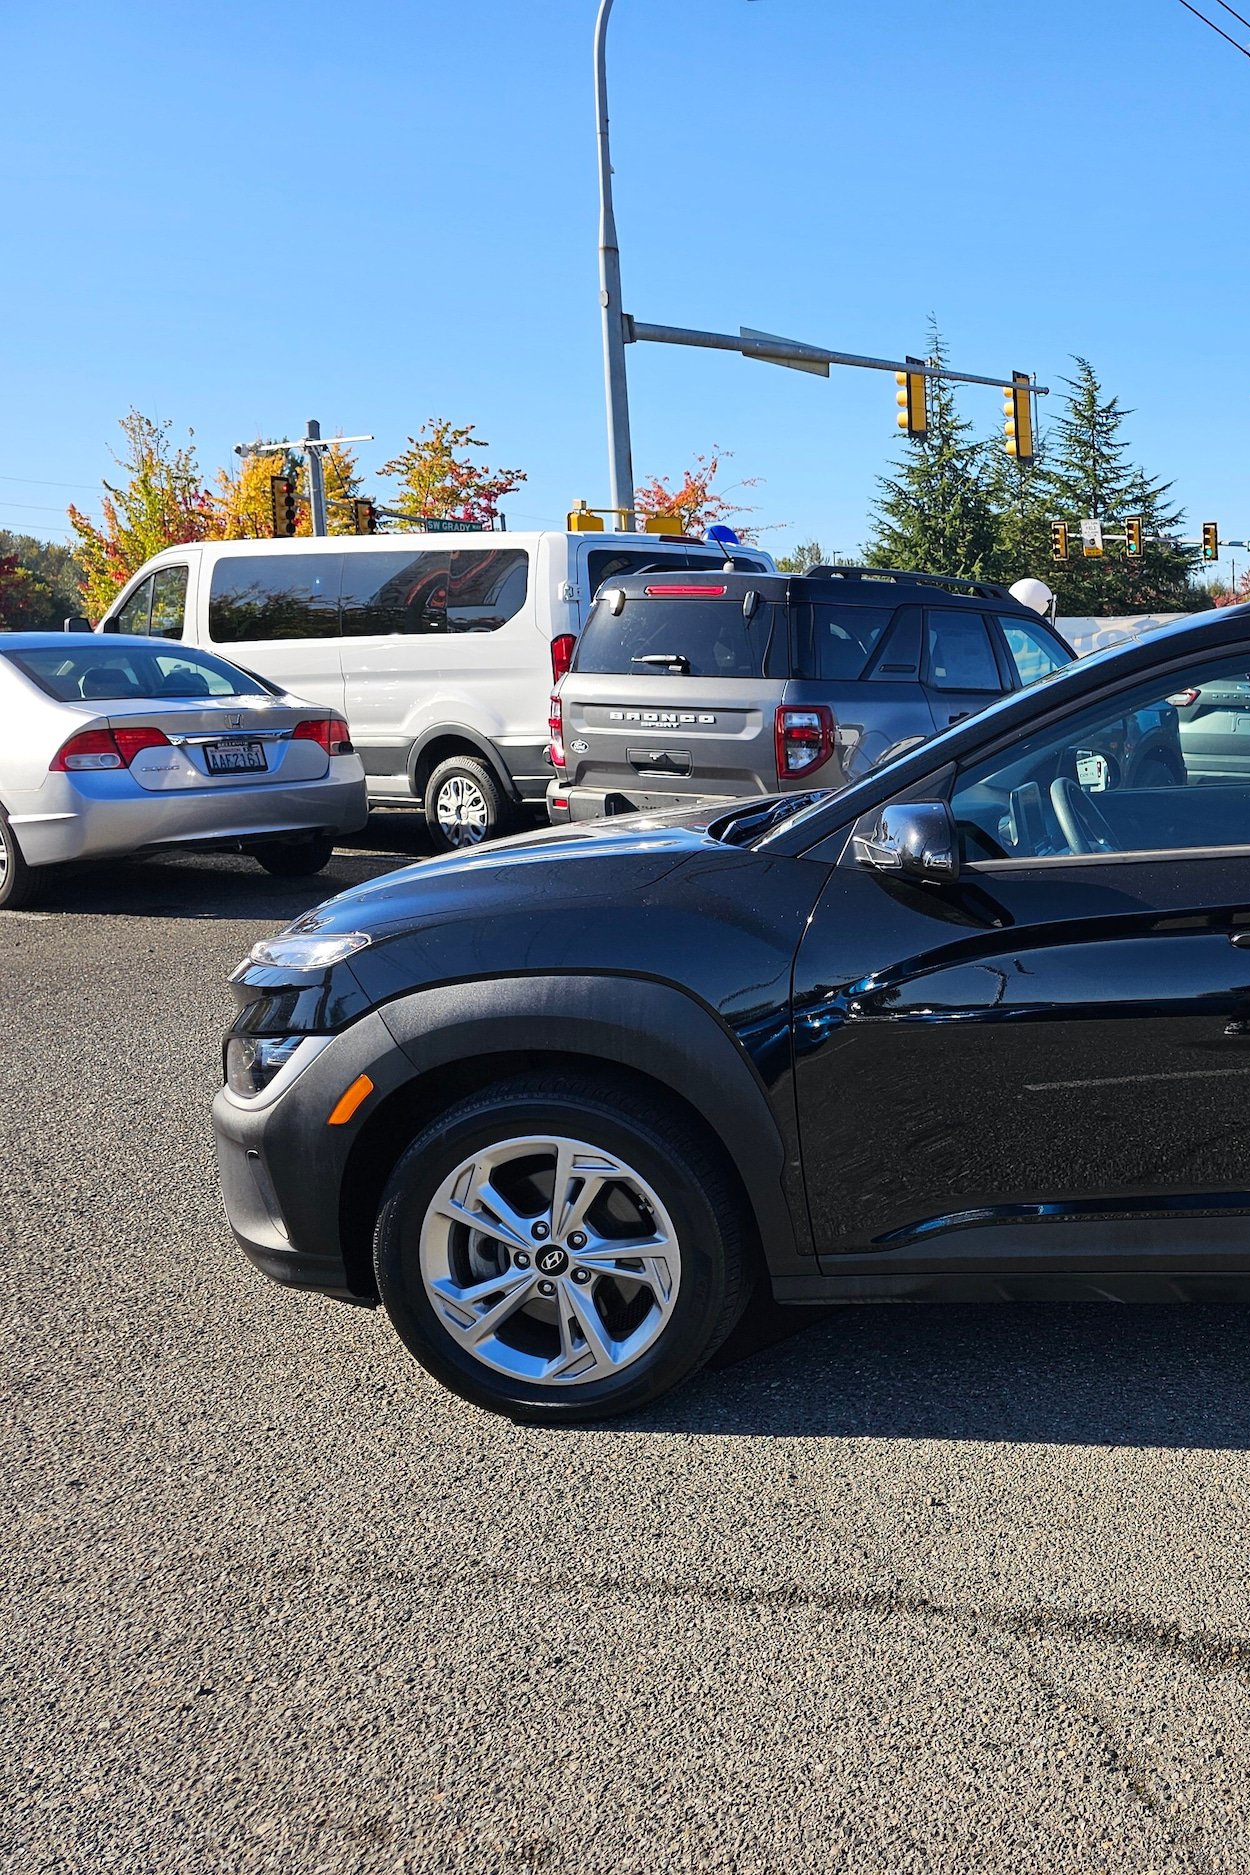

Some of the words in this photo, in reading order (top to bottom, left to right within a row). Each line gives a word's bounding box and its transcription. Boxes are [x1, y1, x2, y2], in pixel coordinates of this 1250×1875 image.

[427, 520, 440, 530] SW
[441, 521, 471, 532] GRADY
[609, 711, 716, 724] BRONCO
[211, 752, 261, 769] AAF2161
